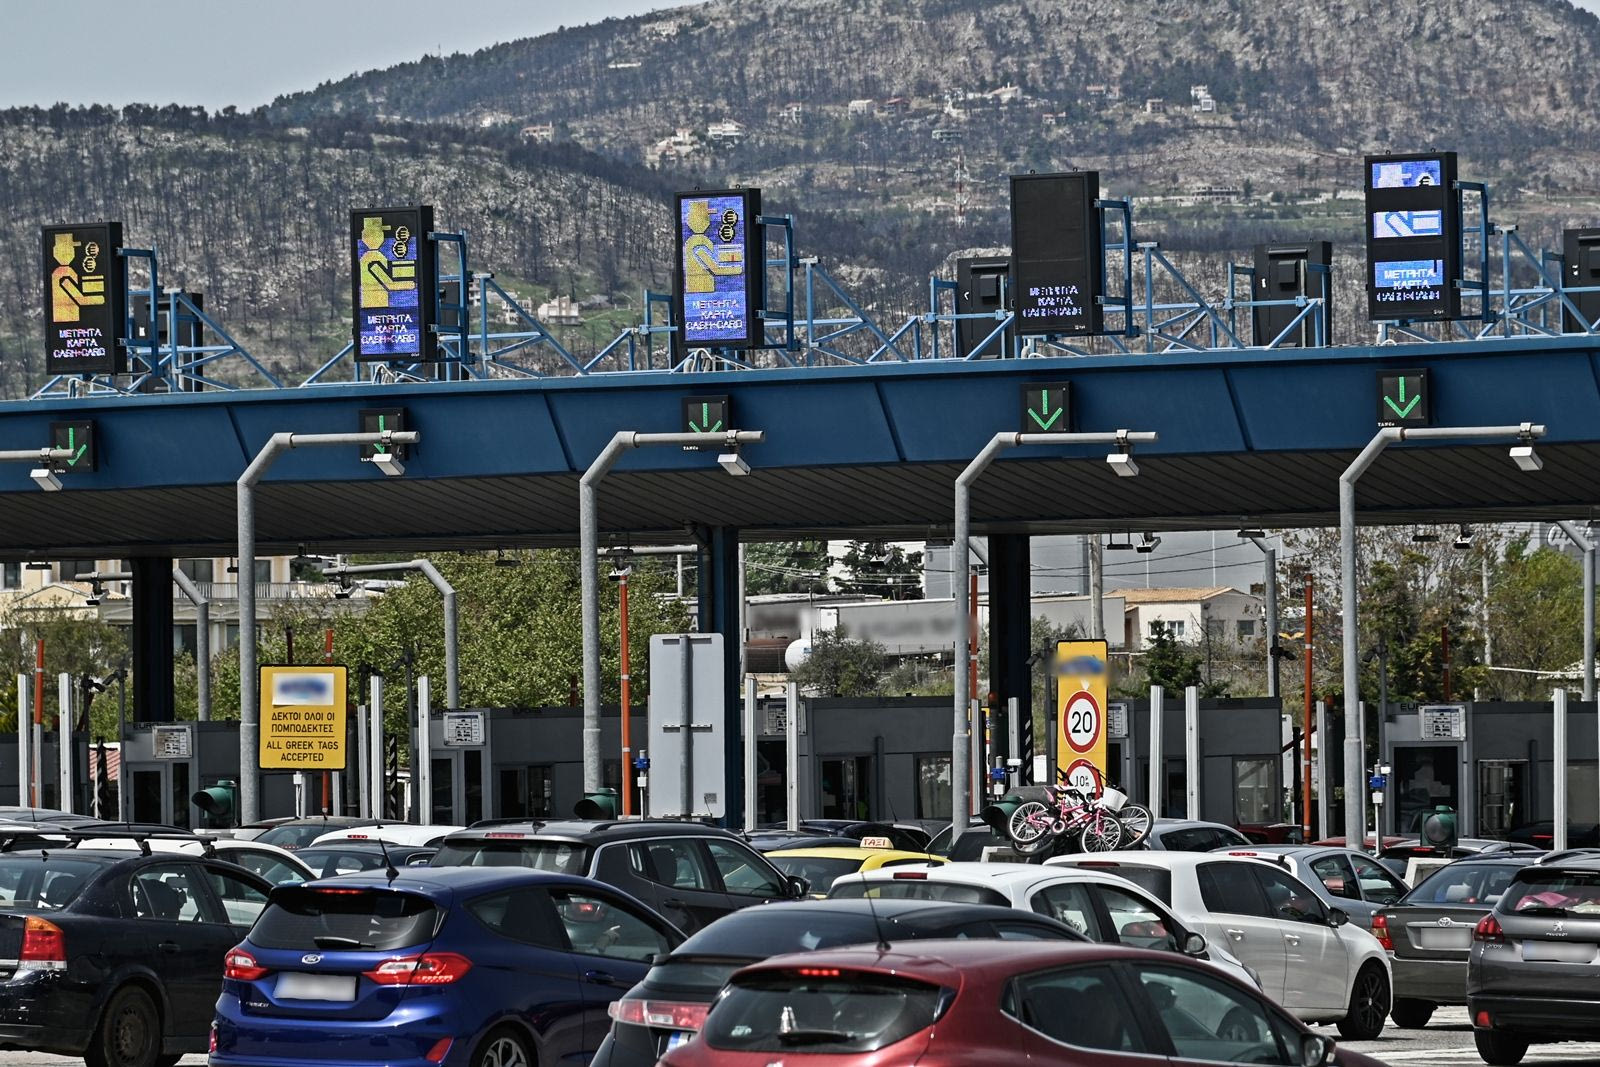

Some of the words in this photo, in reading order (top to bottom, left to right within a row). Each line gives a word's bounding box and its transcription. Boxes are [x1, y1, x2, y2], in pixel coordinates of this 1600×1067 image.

[271, 712, 301, 721] ΔΕΚΤΟΙ
[304, 712, 324, 721] ΟΛΟΙ
[327, 712, 335, 721] ΟΙ
[1071, 711, 1093, 734] 20
[271, 724, 334, 733] ΠΟΜΠΟΔΕΚΤΕΣ
[266, 741, 282, 750] ALL
[285, 741, 314, 750] GREEK
[318, 741, 339, 750] TAGS
[281, 753, 324, 762] ACCEPTED
